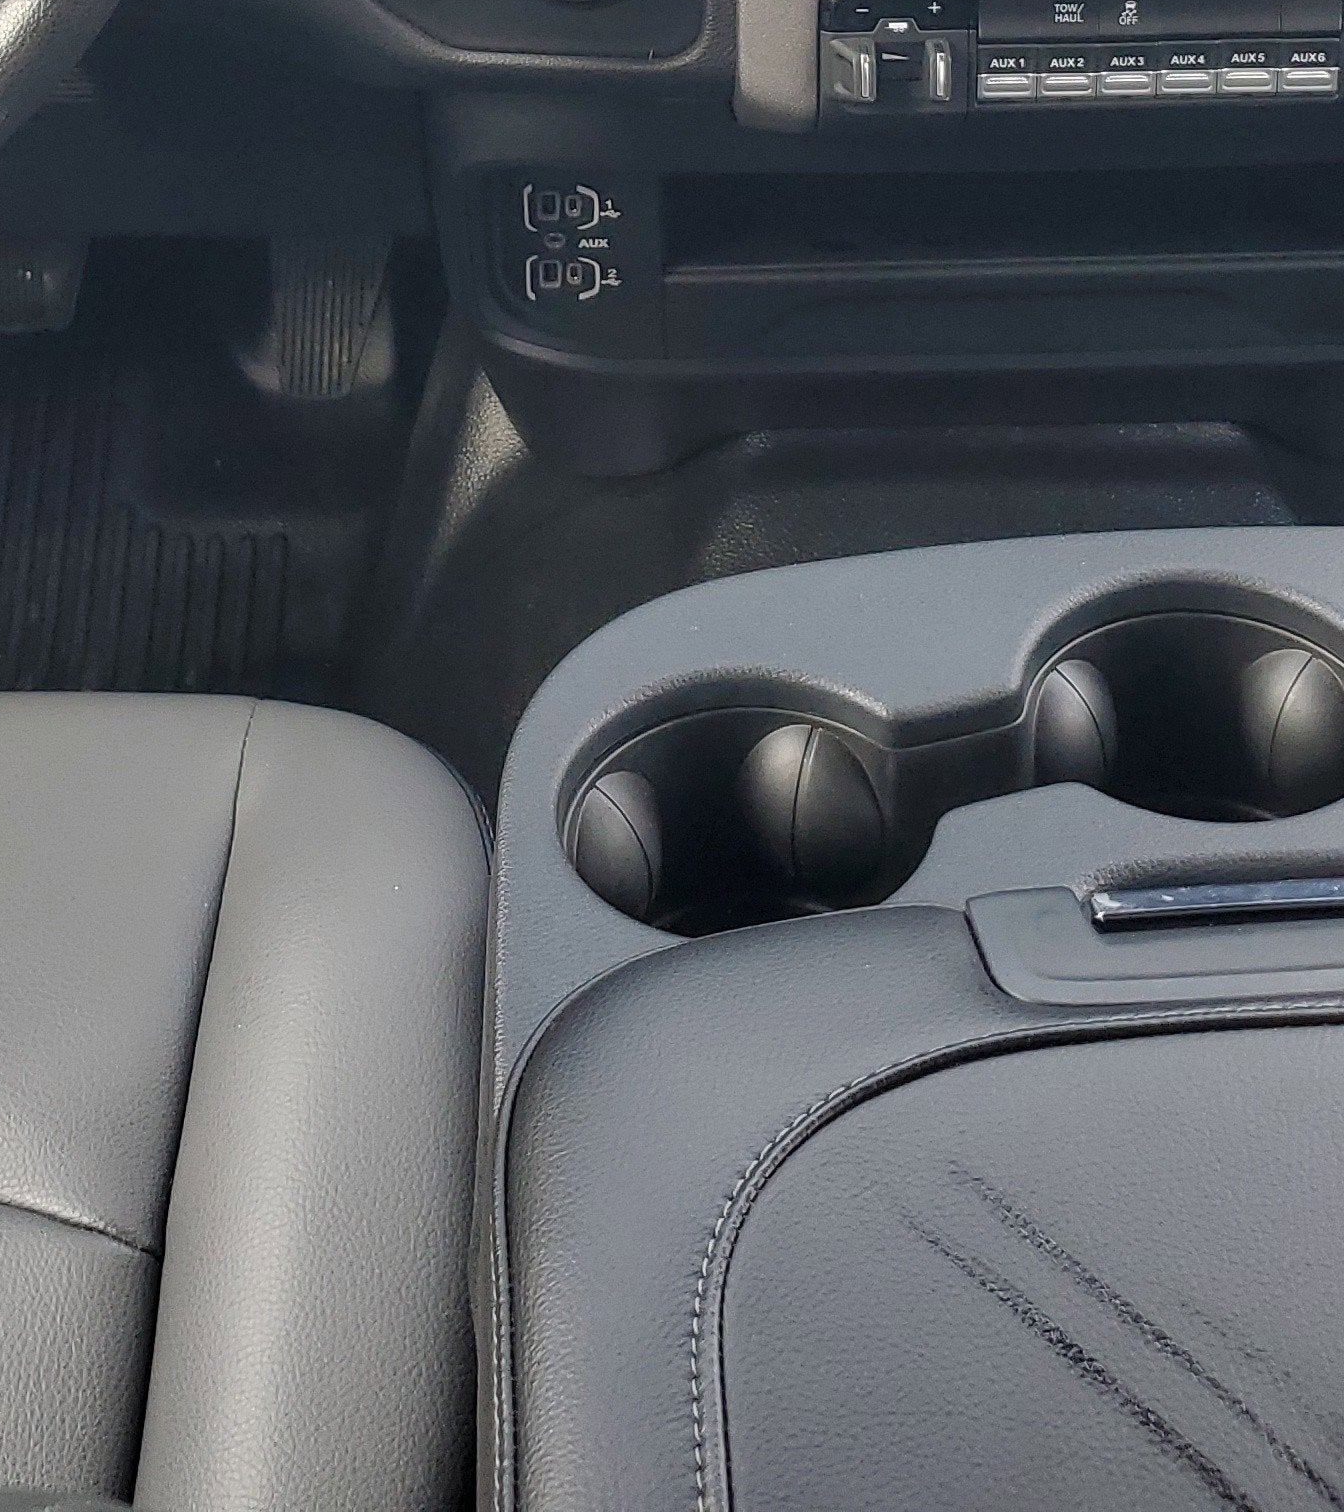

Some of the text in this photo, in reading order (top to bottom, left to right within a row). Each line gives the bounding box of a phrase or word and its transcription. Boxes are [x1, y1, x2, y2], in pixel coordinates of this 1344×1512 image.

[1054, 12, 1084, 23] HAUL
[1118, 15, 1138, 26] OFF
[989, 58, 1026, 68] AUX 1
[1049, 57, 1085, 68] AUX 2
[1109, 56, 1145, 67] AUX 3
[1170, 54, 1205, 65] AUX 4
[1230, 52, 1266, 63] AUX 5
[1290, 52, 1326, 63] AUX 6
[577, 238, 611, 249] AUX
